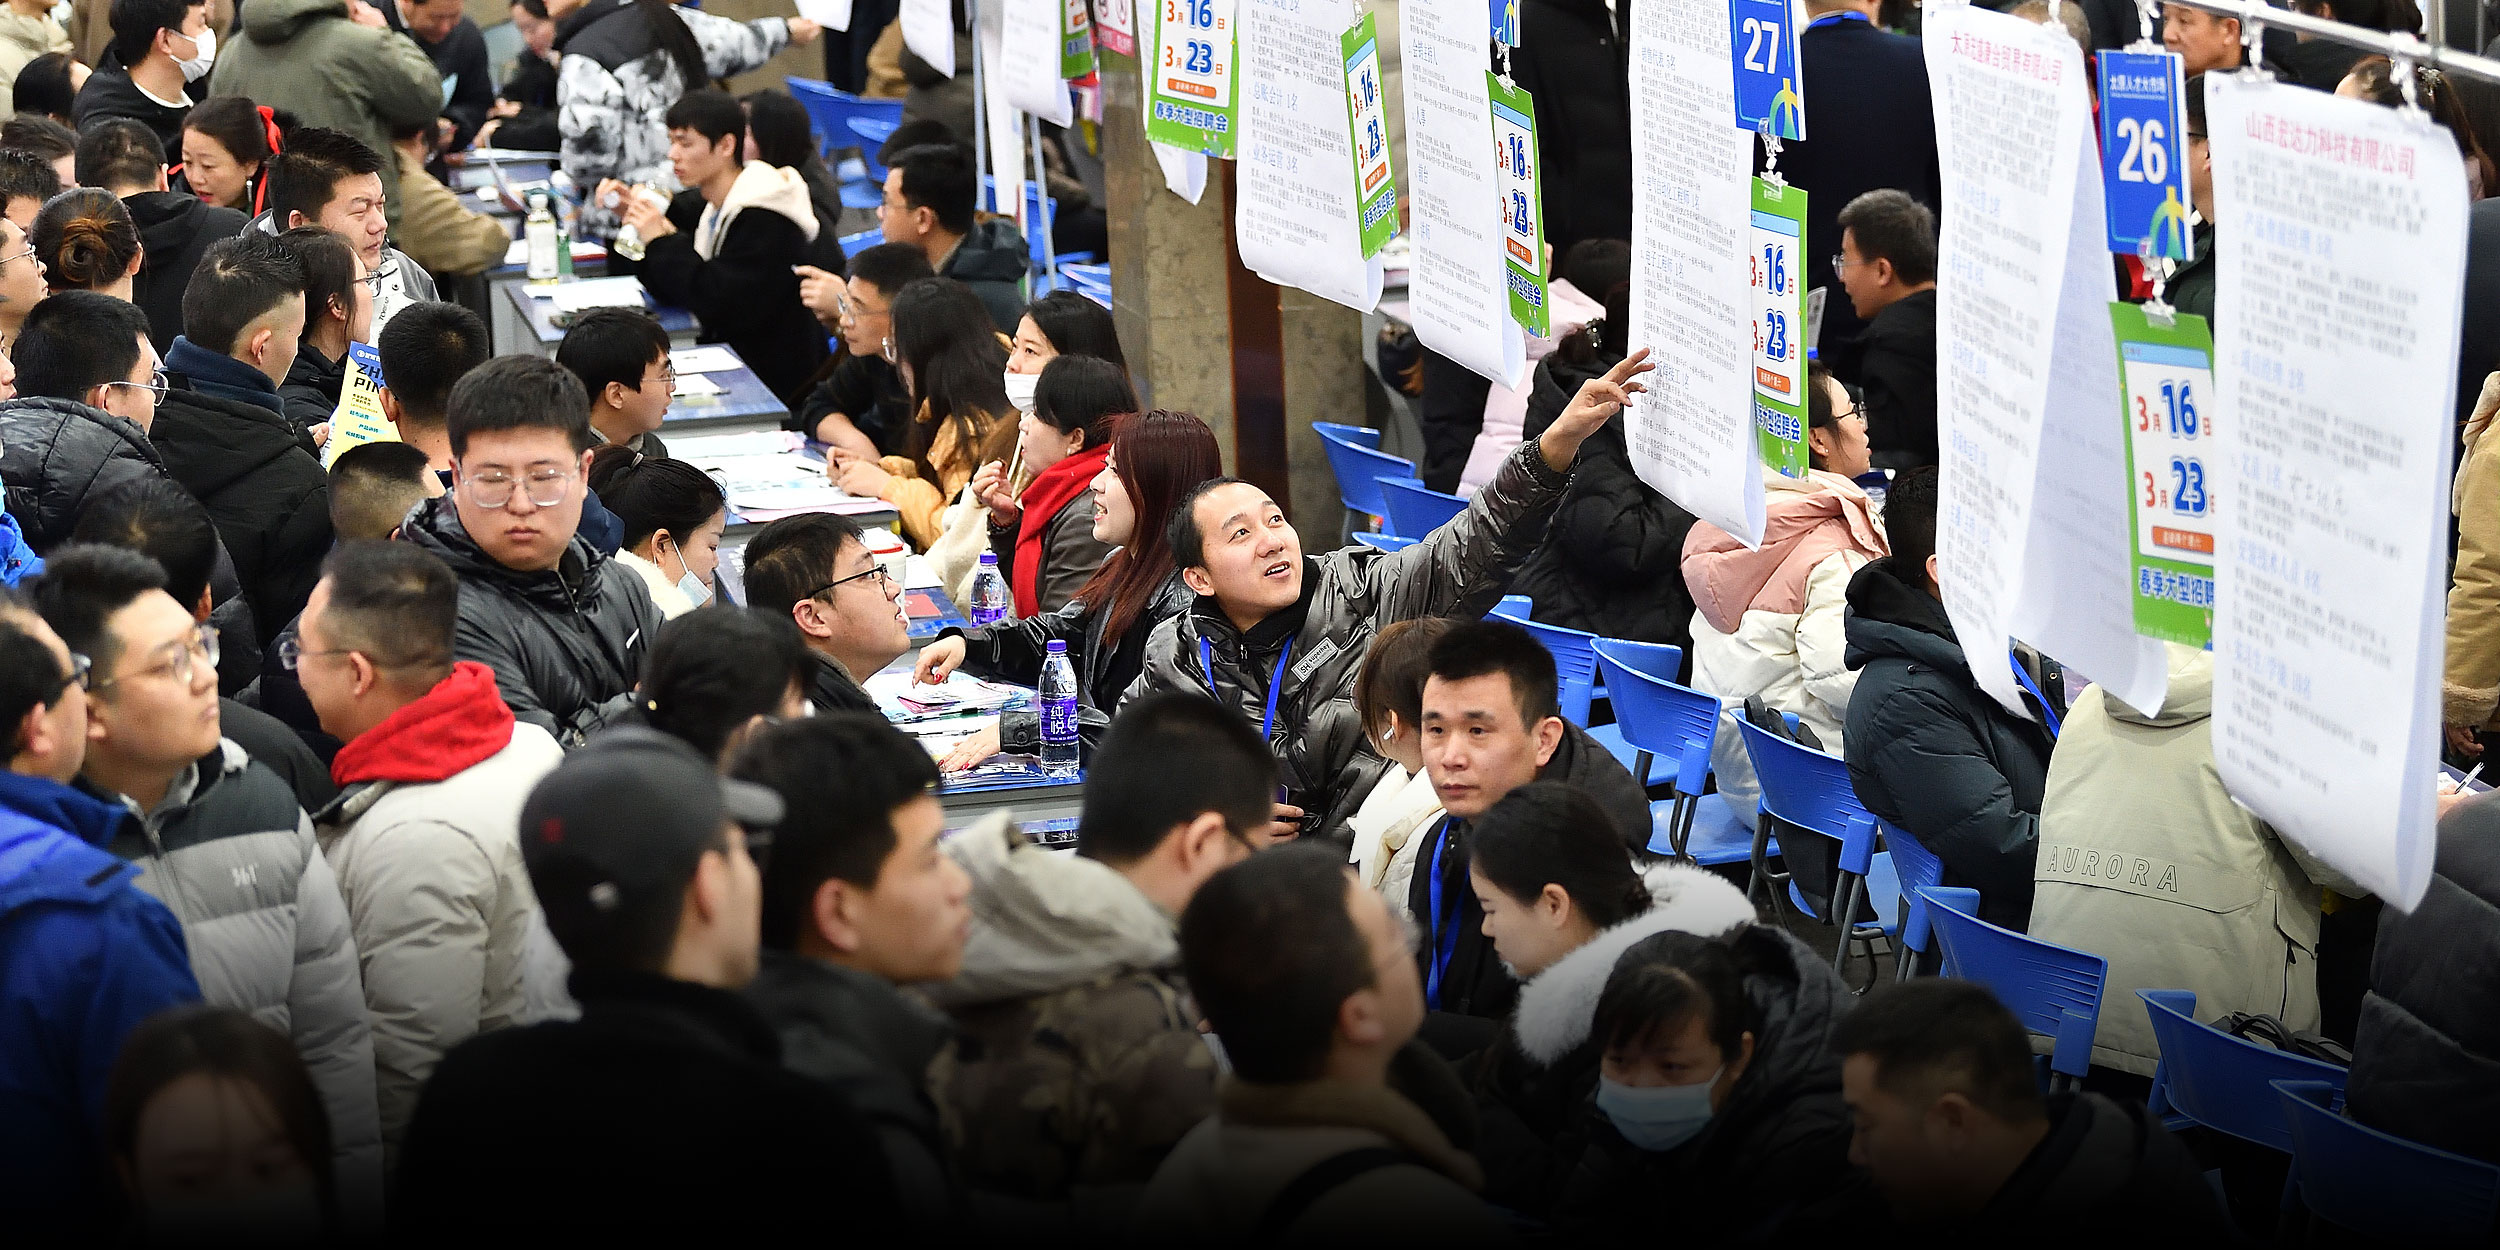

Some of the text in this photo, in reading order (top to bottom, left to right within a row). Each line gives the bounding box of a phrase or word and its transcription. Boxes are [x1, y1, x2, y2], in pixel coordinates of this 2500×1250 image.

[1165, 41, 1224, 75] 3月23日
[1742, 17, 1780, 75] 27
[1155, 100, 1228, 132] 春季大型招聘会
[2117, 118, 2167, 184] 26
[1364, 187, 1395, 231] 春季大型招聘会
[357, 362, 384, 380] ZH
[1300, 663, 1312, 674] SH
[1051, 706, 1066, 734] 纯悦
[2047, 846, 2177, 892] AURORA
